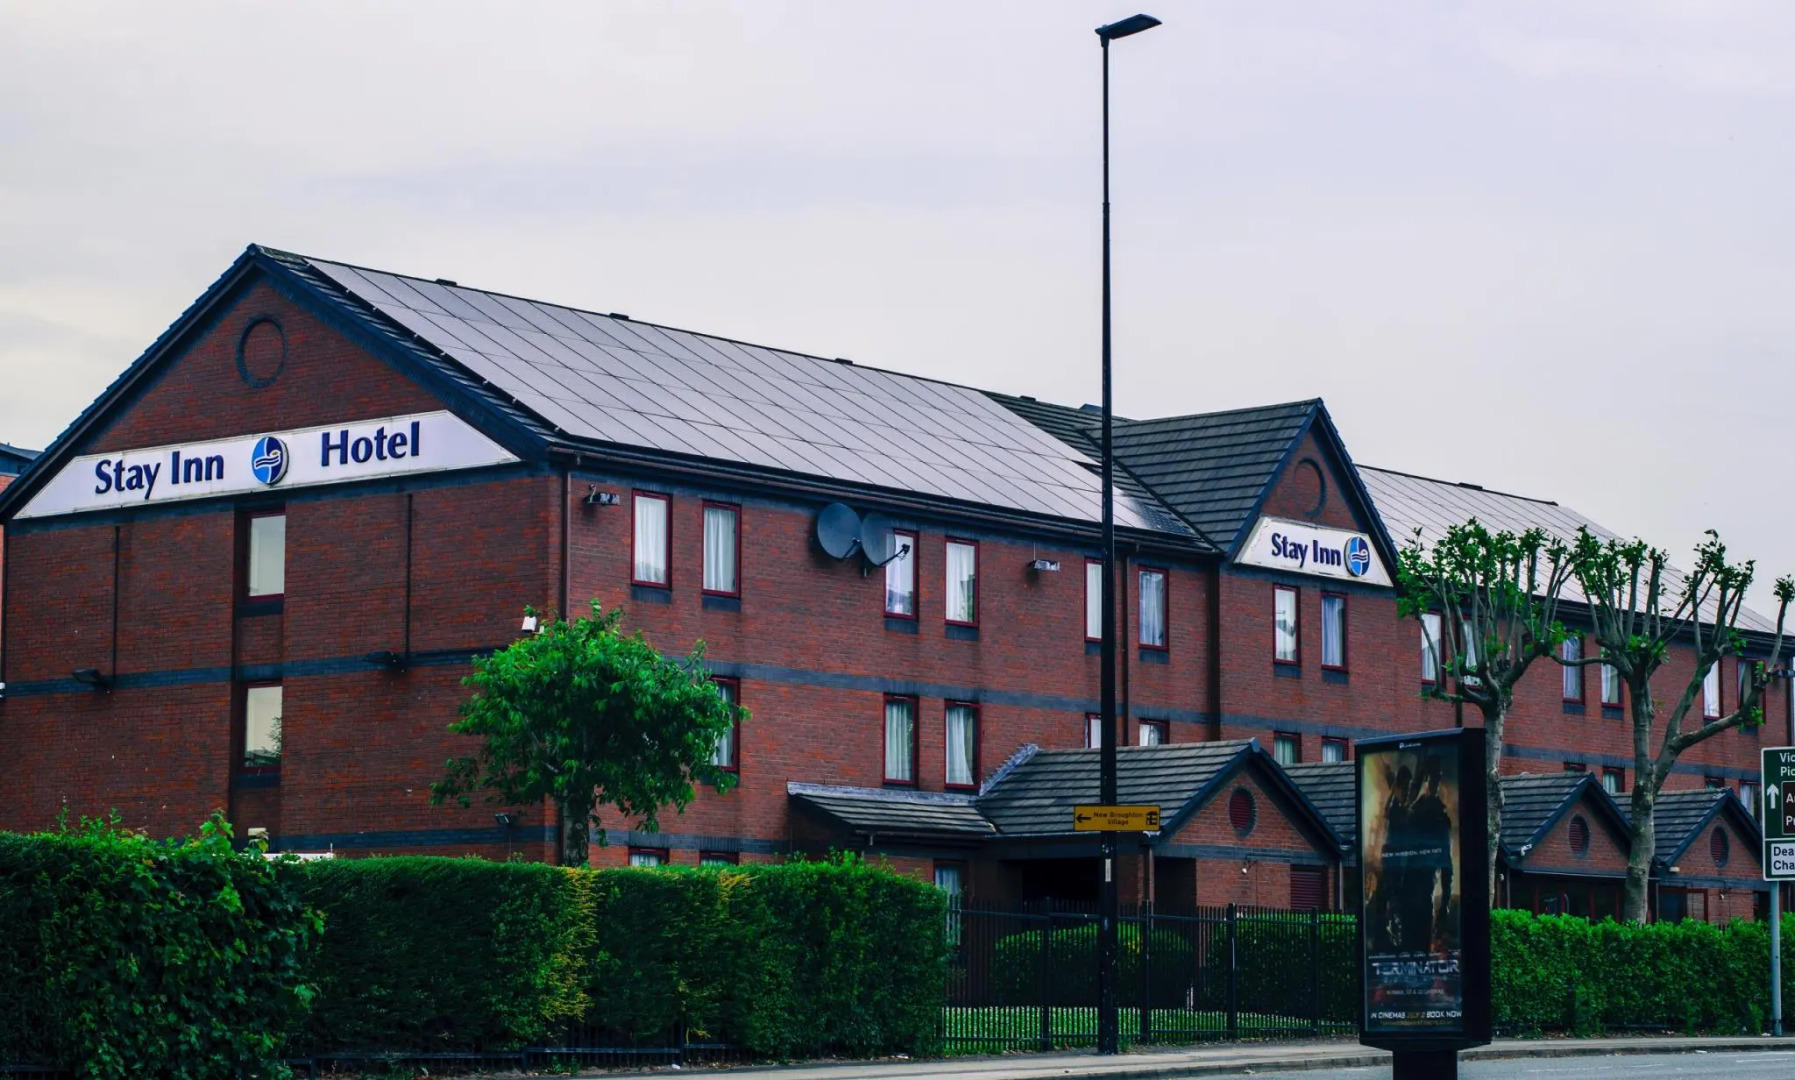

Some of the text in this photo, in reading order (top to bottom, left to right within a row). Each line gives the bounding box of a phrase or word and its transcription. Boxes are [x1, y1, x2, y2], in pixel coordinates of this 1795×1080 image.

[95, 420, 420, 500] Stay Inn Hotel
[1271, 532, 1342, 568] Stay Inn
[1110, 811, 1143, 819] Broughton
[1107, 818, 1129, 826] Village
[1371, 959, 1460, 976] TERMINATOR
[1378, 1011, 1406, 1019] CINEMAS
[1426, 1010, 1445, 1018] BOOK
[1446, 1010, 1462, 1018] NOW
